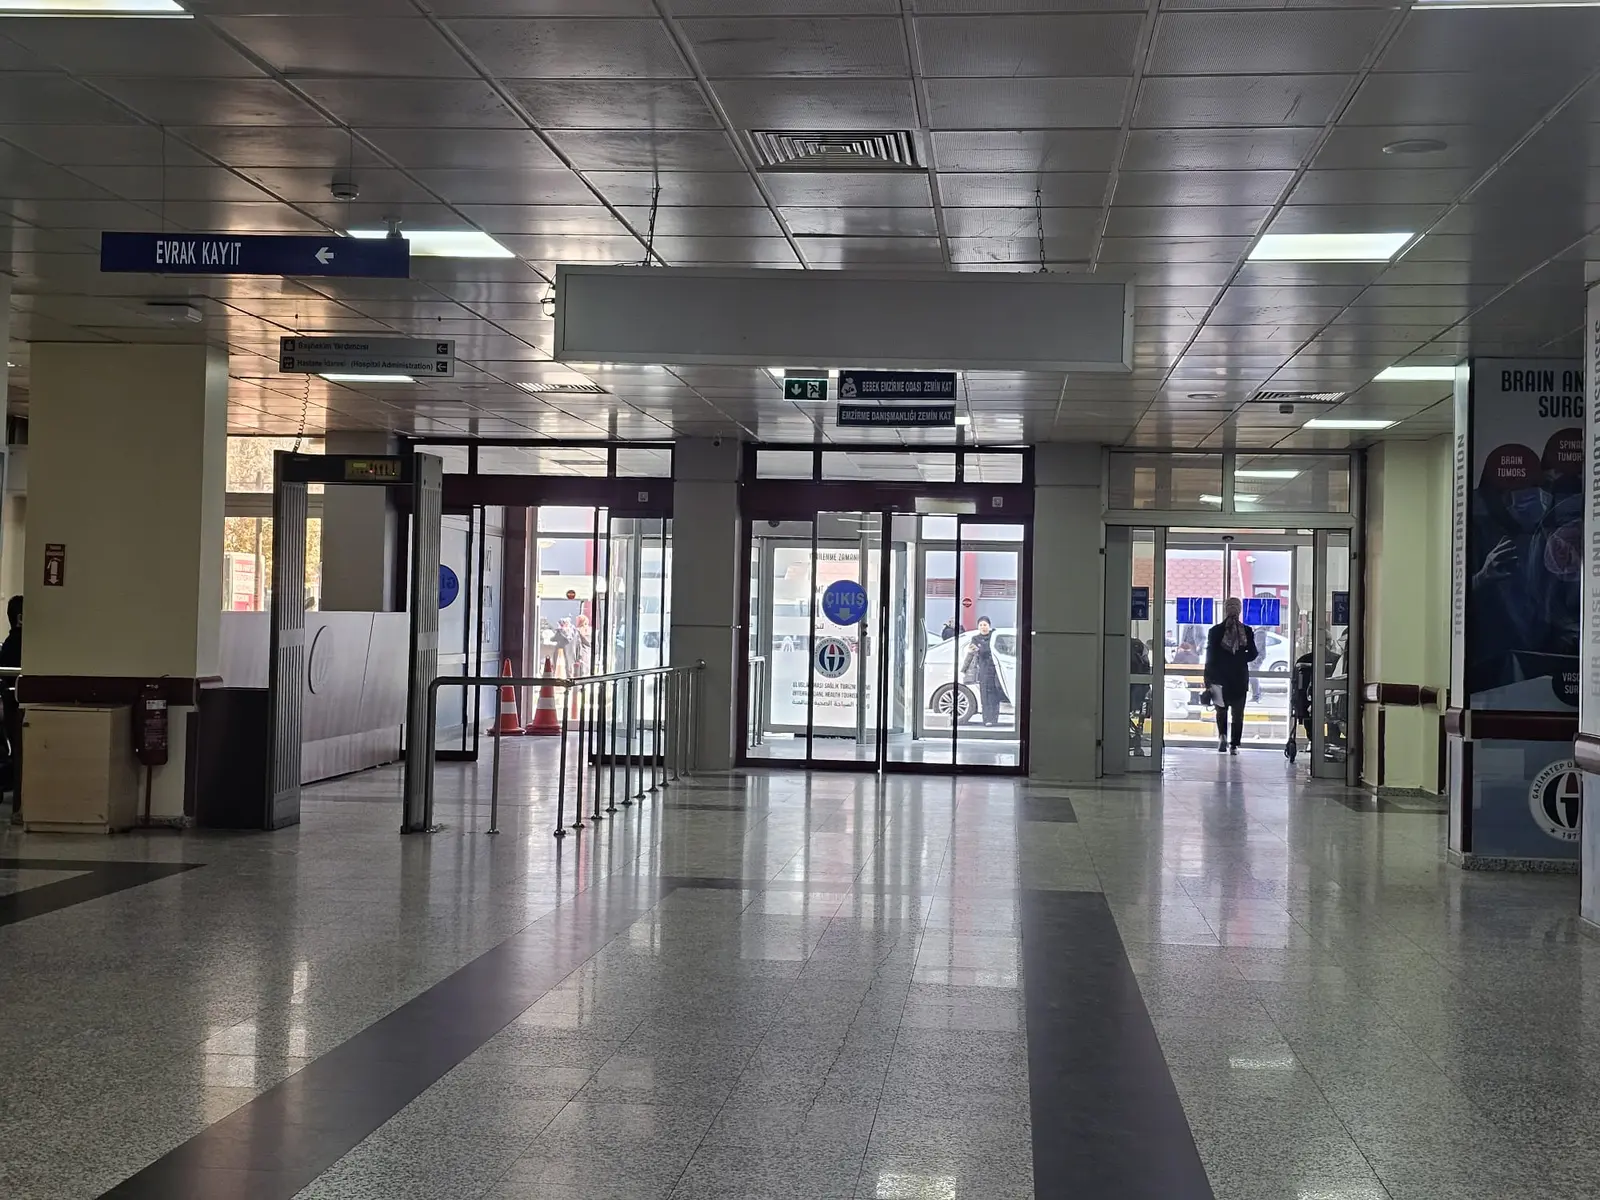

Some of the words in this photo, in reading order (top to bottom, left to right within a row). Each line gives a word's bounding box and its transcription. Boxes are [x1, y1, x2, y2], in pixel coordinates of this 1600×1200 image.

[156, 240, 197, 265] EVRAK
[202, 241, 242, 266] KAYIT
[381, 361, 433, 371] Administration)
[862, 381, 880, 392] BEBEK
[923, 379, 941, 392] ZEMİN
[941, 381, 953, 392] KAT
[1501, 370, 1554, 393] BRAIN
[1562, 370, 1584, 393] AN
[1538, 395, 1584, 418] SURG
[841, 409, 871, 421] EMZİRME
[917, 410, 938, 421] ZEMİN
[939, 411, 952, 421] KAT
[1559, 440, 1583, 450] SPINA
[1501, 455, 1523, 465] BRAIN
[1558, 452, 1583, 461] TUMOR
[1497, 467, 1526, 477] TUMORS
[1454, 433, 1465, 637] TRANSPLANTATION
[1592, 531, 1600, 577] AND
[825, 591, 865, 609] ÇIKIŞ
[1591, 587, 1600, 643] NOSE
[1561, 671, 1580, 683] VASC
[1564, 684, 1579, 695] SUR
